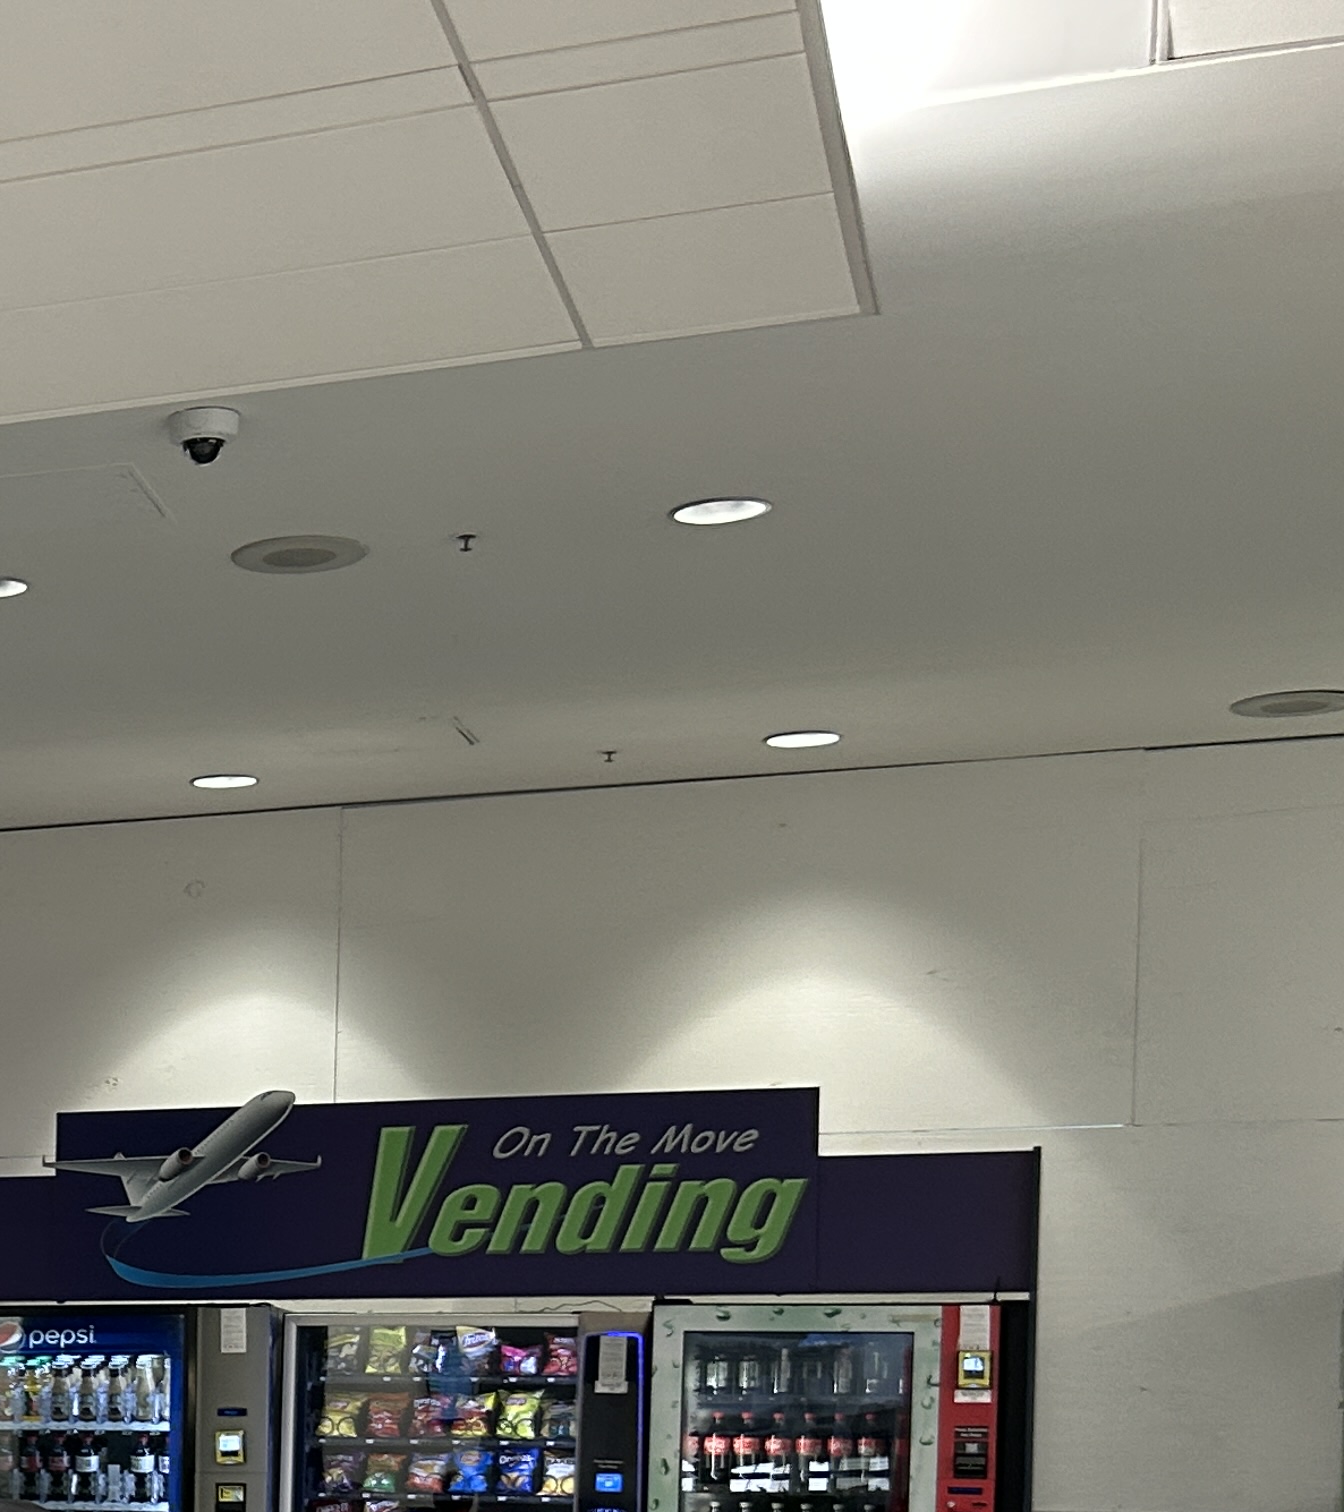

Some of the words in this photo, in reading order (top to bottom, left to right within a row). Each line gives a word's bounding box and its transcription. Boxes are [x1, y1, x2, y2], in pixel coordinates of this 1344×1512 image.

[492, 1125, 552, 1160] On
[569, 1124, 641, 1157] The
[650, 1123, 760, 1155] Move
[361, 1123, 809, 1265] Vending
[29, 1324, 95, 1349] pepsi
